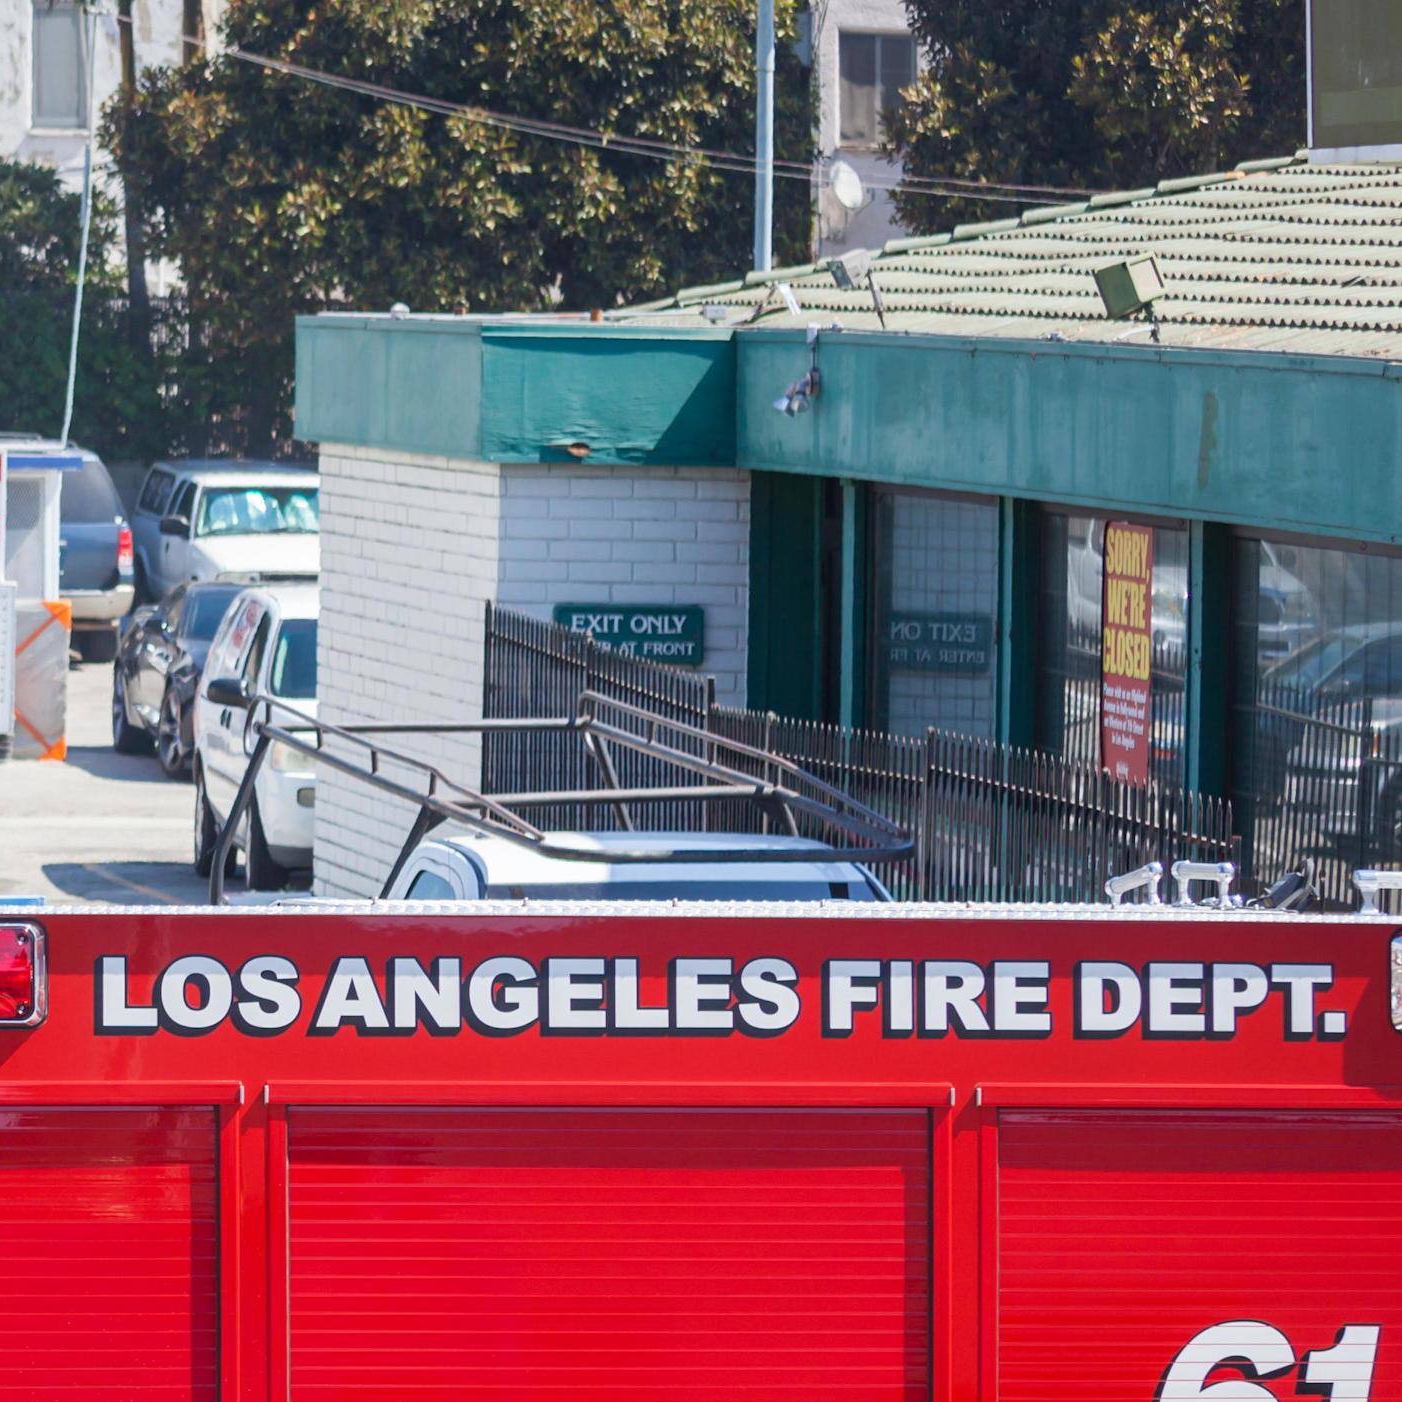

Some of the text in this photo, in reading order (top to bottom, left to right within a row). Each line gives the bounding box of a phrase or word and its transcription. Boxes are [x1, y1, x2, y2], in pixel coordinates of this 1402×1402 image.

[1105, 527, 1150, 584] SORRY,
[571, 613, 687, 635] EXIT ONLY
[1107, 578, 1147, 630] WE'RE
[643, 642, 696, 656] FRONT
[1103, 626, 1151, 681] CLOSED
[94, 954, 1347, 1042] LOS ANGELES FIRE DEPT.
